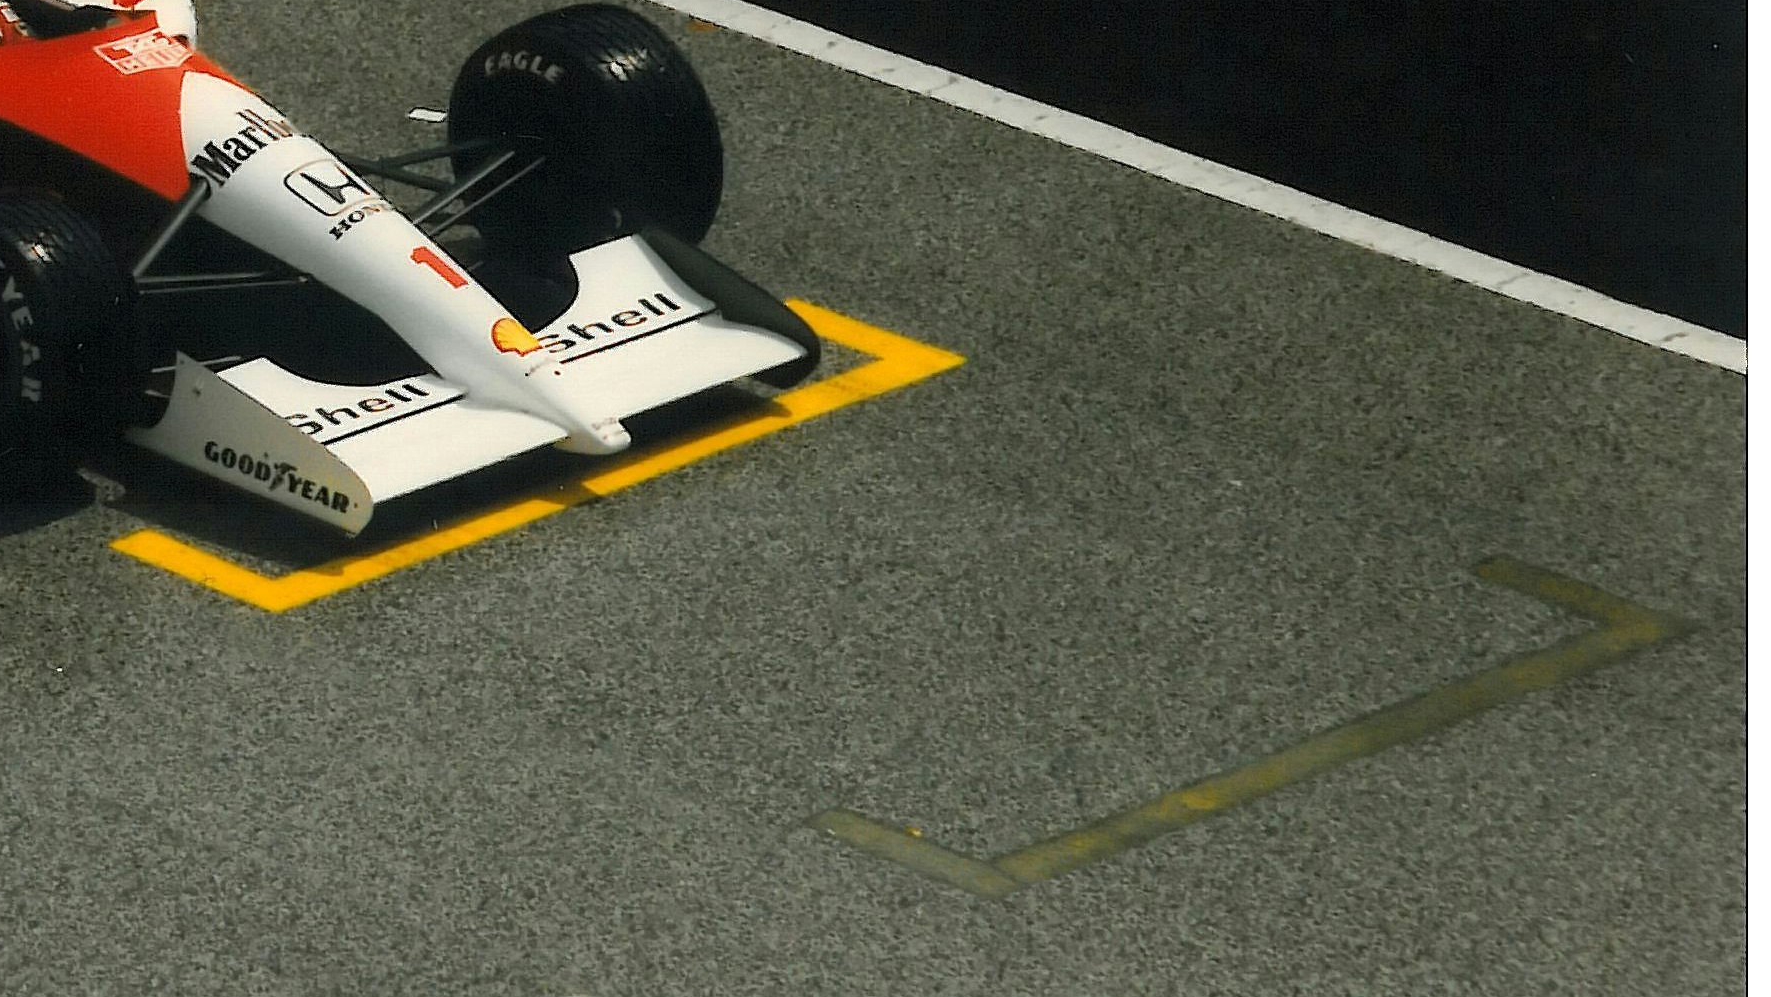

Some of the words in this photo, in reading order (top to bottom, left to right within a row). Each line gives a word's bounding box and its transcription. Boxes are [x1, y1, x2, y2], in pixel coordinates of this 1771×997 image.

[482, 49, 566, 83] EAGLE
[410, 246, 469, 289] 1
[539, 292, 681, 353] Shell
[283, 383, 430, 437] Shell
[203, 440, 351, 515] GOODYEAR
